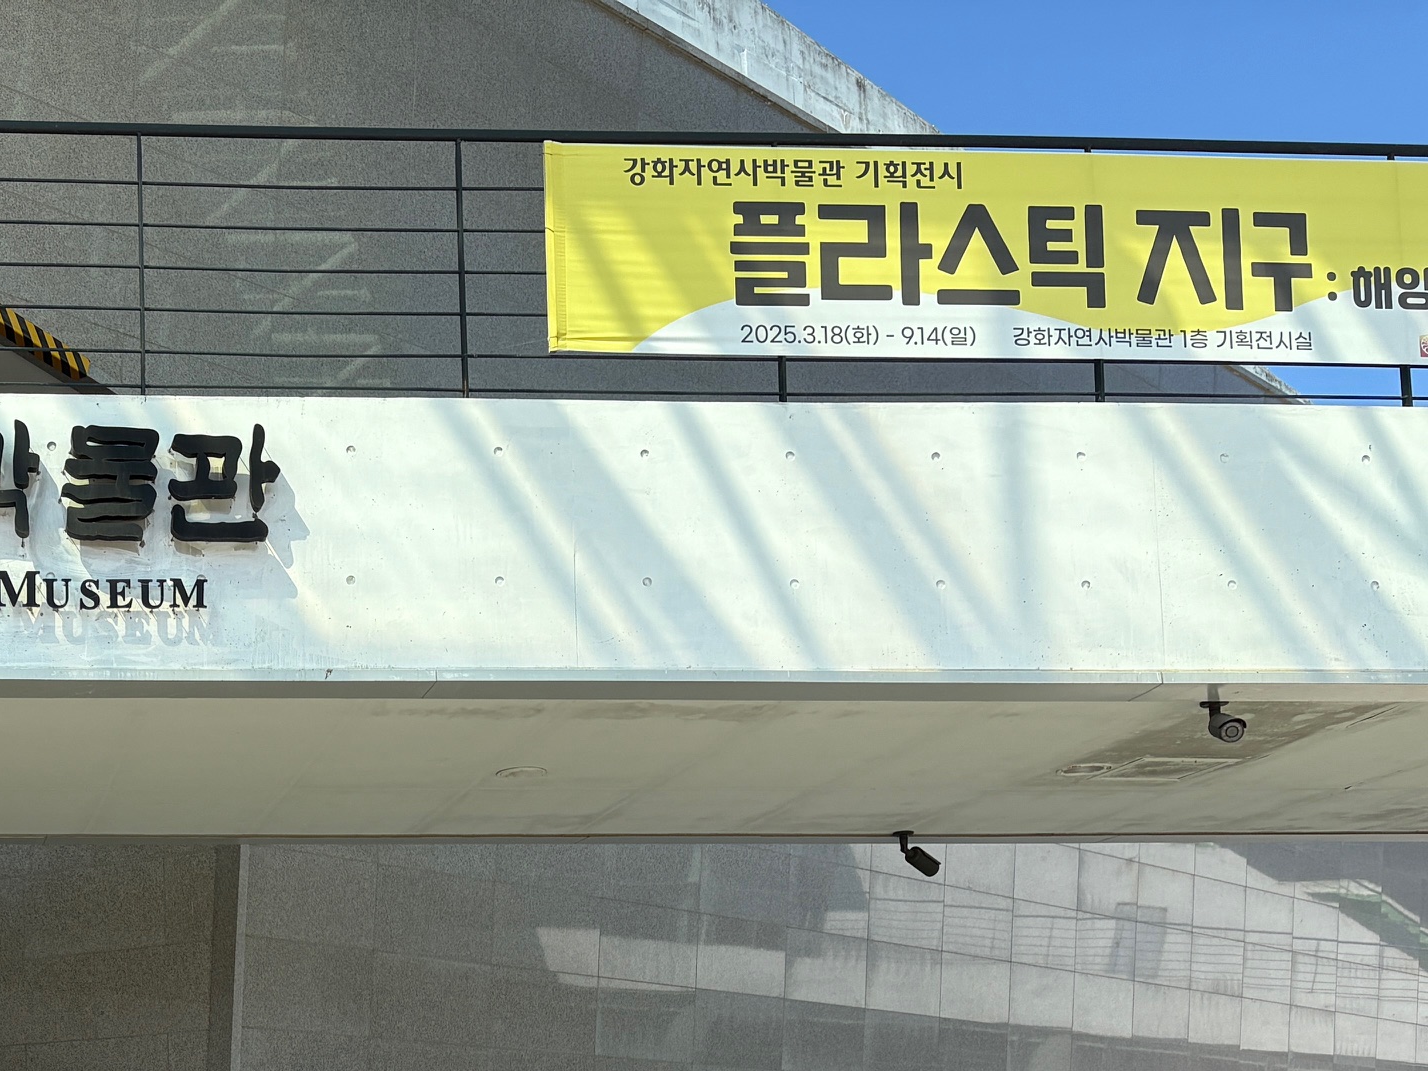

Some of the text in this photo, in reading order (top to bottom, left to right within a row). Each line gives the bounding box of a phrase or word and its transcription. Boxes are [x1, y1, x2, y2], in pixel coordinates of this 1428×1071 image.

[623, 157, 964, 190] 강화자연사박물관 기획전시
[729, 201, 1107, 308] 플라스틱
[1135, 207, 1313, 311] 지구
[740, 324, 879, 346] 2025.3.18(화)
[901, 326, 976, 346] 9.14(일)
[1012, 327, 1174, 348] 강화자연사박물관
[1179, 329, 1208, 349] 1층
[1216, 330, 1313, 351] 기획전시실
